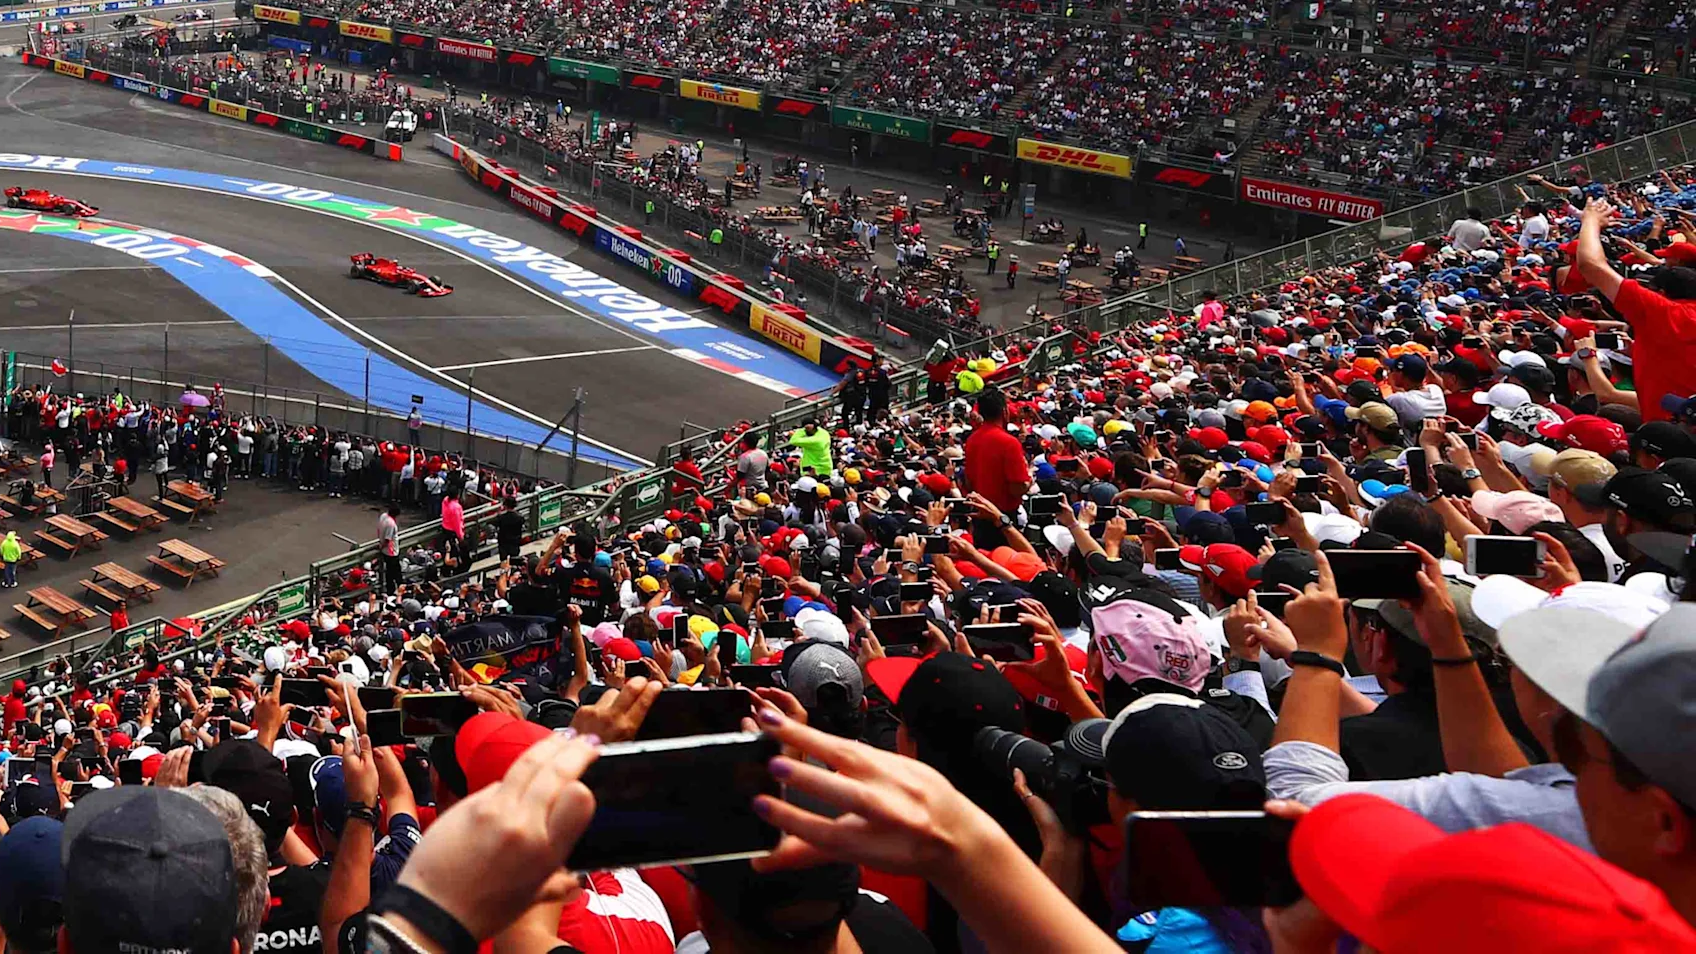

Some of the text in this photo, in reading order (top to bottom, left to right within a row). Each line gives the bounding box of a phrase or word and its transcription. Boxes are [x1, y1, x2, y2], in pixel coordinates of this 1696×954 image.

[259, 7, 290, 21] DHL
[347, 24, 378, 39] DHL
[696, 85, 740, 104] PIRELLI
[1032, 145, 1105, 171] DHL
[1245, 183, 1375, 220] Emirates FLY BETTER
[610, 237, 650, 271] Heineken
[442, 222, 719, 333] Heineken
[762, 314, 807, 352] PIRELLI
[1165, 653, 1190, 670] RED
